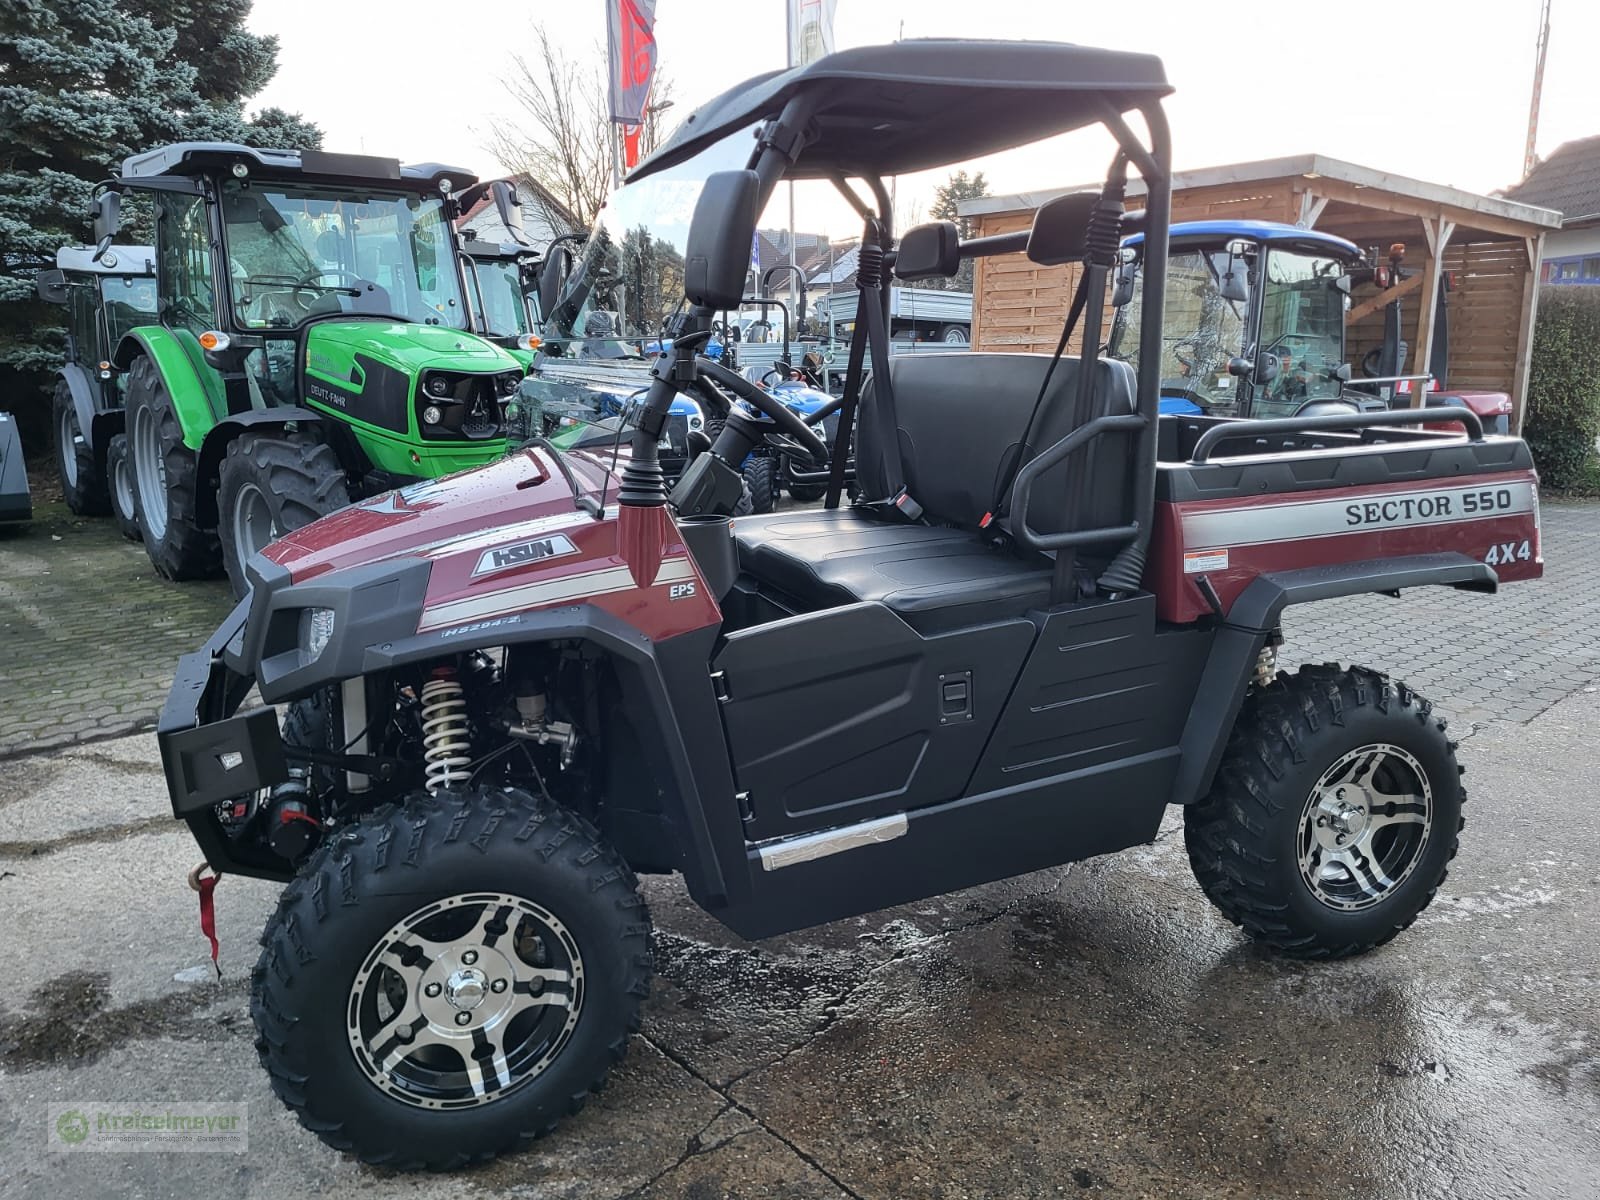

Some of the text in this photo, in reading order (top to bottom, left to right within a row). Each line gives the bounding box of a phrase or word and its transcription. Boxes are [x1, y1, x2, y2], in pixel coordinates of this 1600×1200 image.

[310, 384, 346, 407] DEUTZ-FAHR
[1345, 489, 1511, 526] SECTOR 550
[491, 540, 555, 567] HSUN
[1484, 540, 1531, 566] 4X4
[670, 582, 695, 598] EPS
